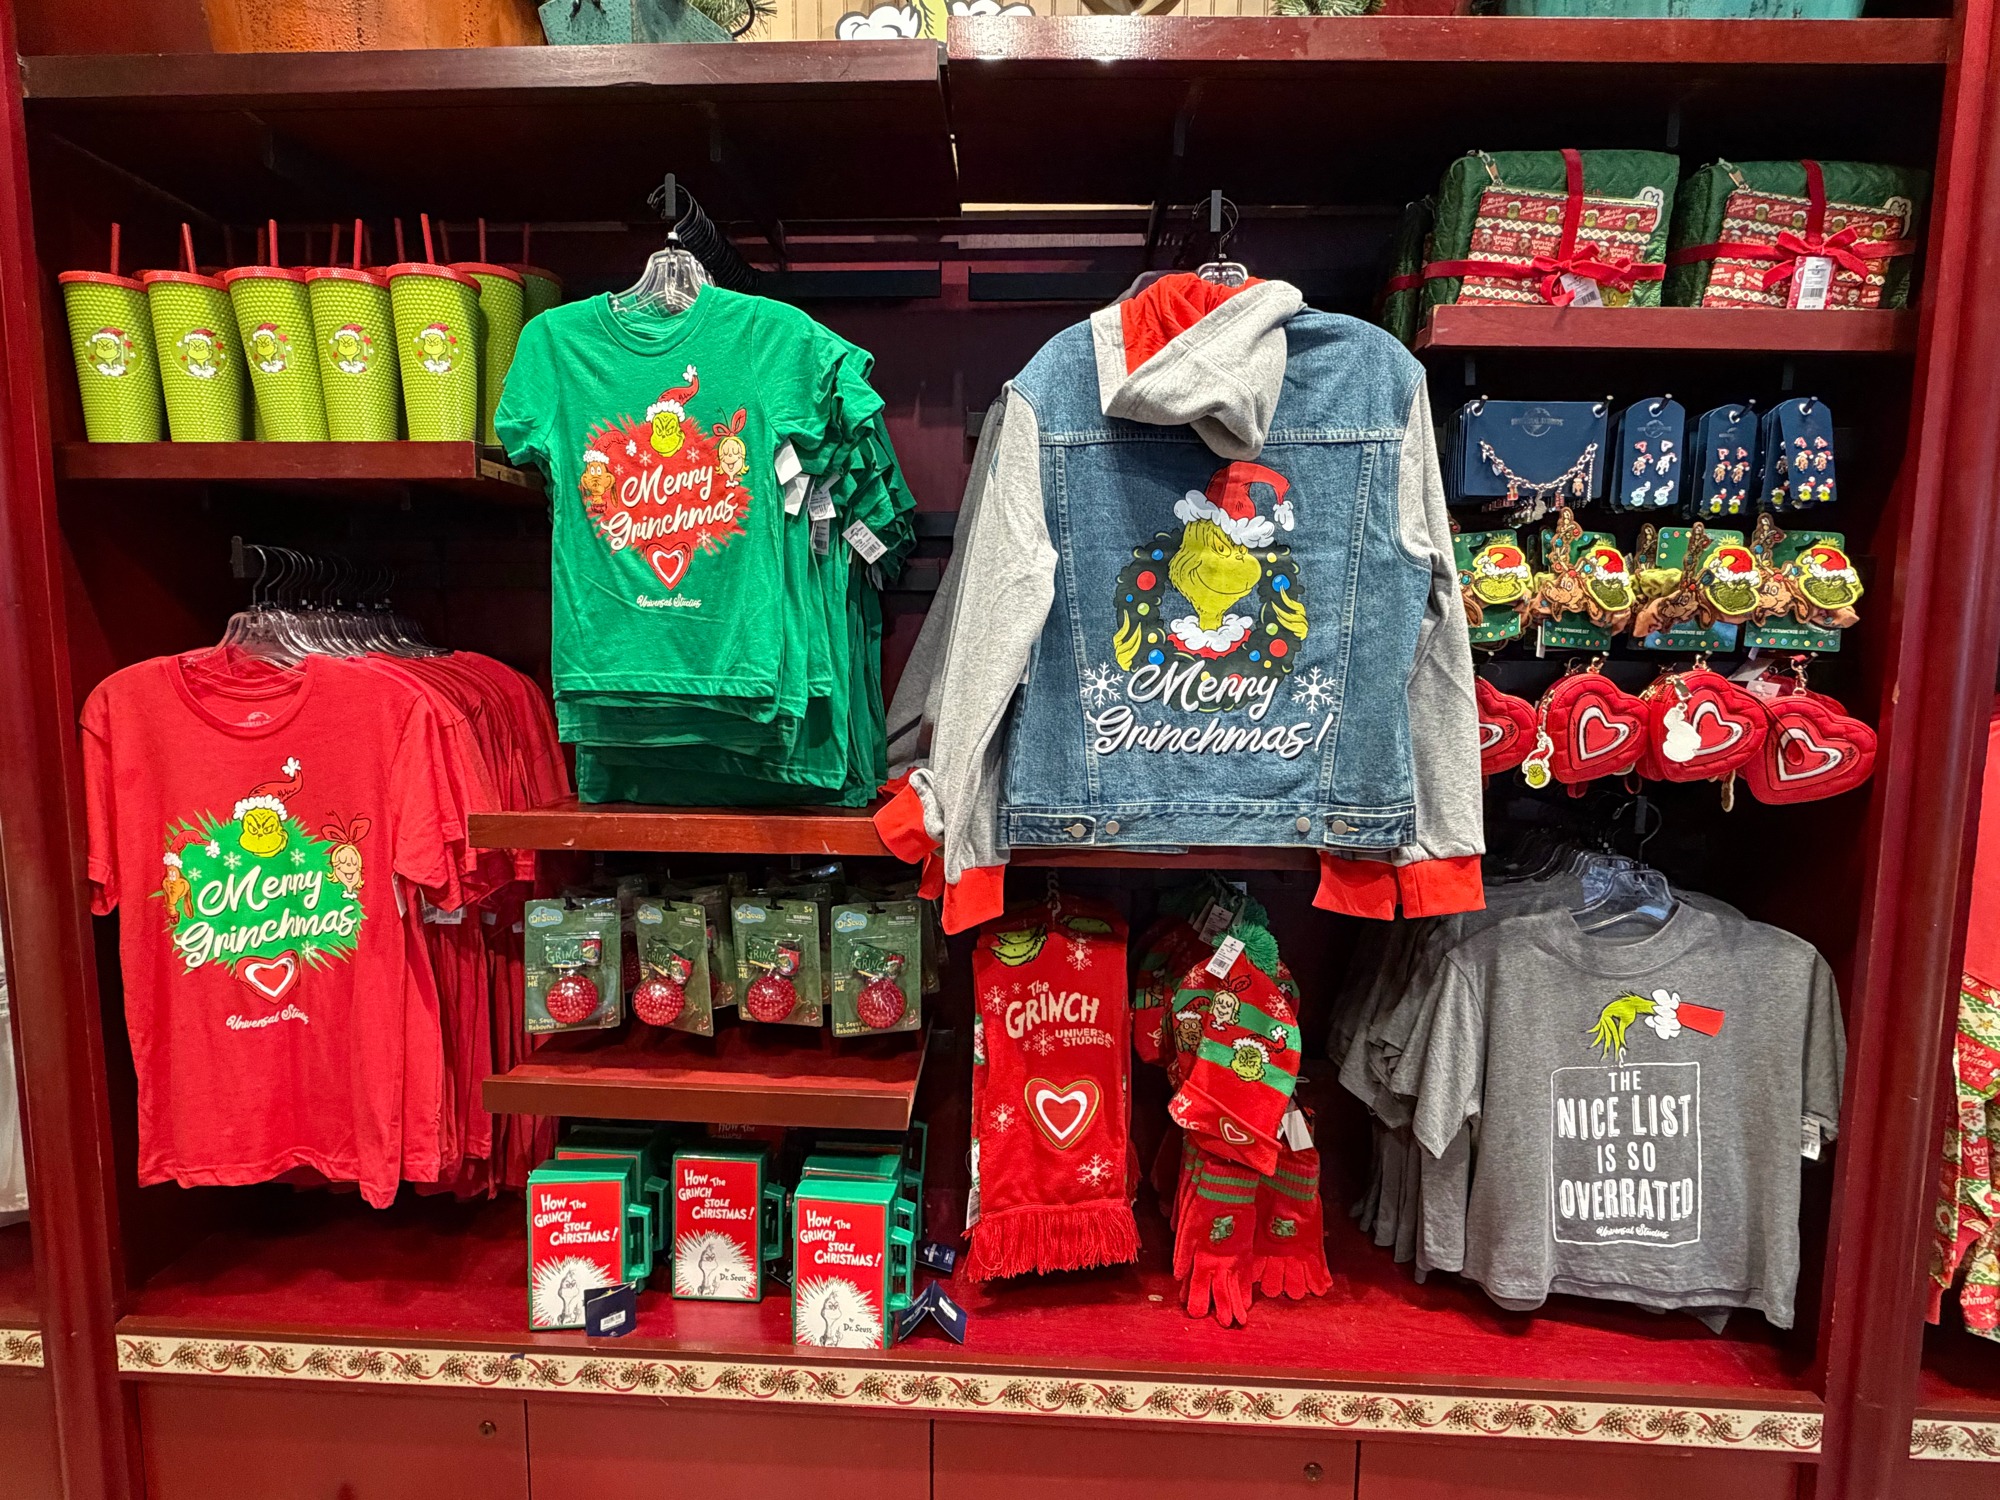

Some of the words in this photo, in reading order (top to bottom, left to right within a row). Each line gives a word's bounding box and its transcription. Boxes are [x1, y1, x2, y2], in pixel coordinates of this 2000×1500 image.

[620, 463, 714, 508] Merry
[600, 493, 739, 551] Grinchmas
[1127, 660, 1279, 721] Merry
[1086, 705, 1334, 760] Grinchmas!
[197, 864, 324, 917] Merry
[172, 904, 358, 969] Grinchmas
[1027, 979, 1050, 997] The
[1005, 990, 1100, 1039] GRINCH
[1062, 1036, 1111, 1049] STUDIOS
[1608, 1070, 1642, 1092] THE
[1556, 1096, 1621, 1141] NICE
[1631, 1094, 1692, 1138] LIST
[1597, 1143, 1617, 1174] IS
[1627, 1141, 1657, 1172] SO
[678, 1186, 712, 1201] GRINCH
[704, 1198, 731, 1208] STOLE
[1558, 1177, 1694, 1222] OVERRATED
[534, 1210, 572, 1228] GRINCH
[563, 1221, 592, 1233] STOLE
[800, 1229, 837, 1244] GRINCH
[827, 1241, 856, 1252] STOLE
[843, 1322, 854, 1332] Dr.
[854, 1324, 873, 1334] Seuss
